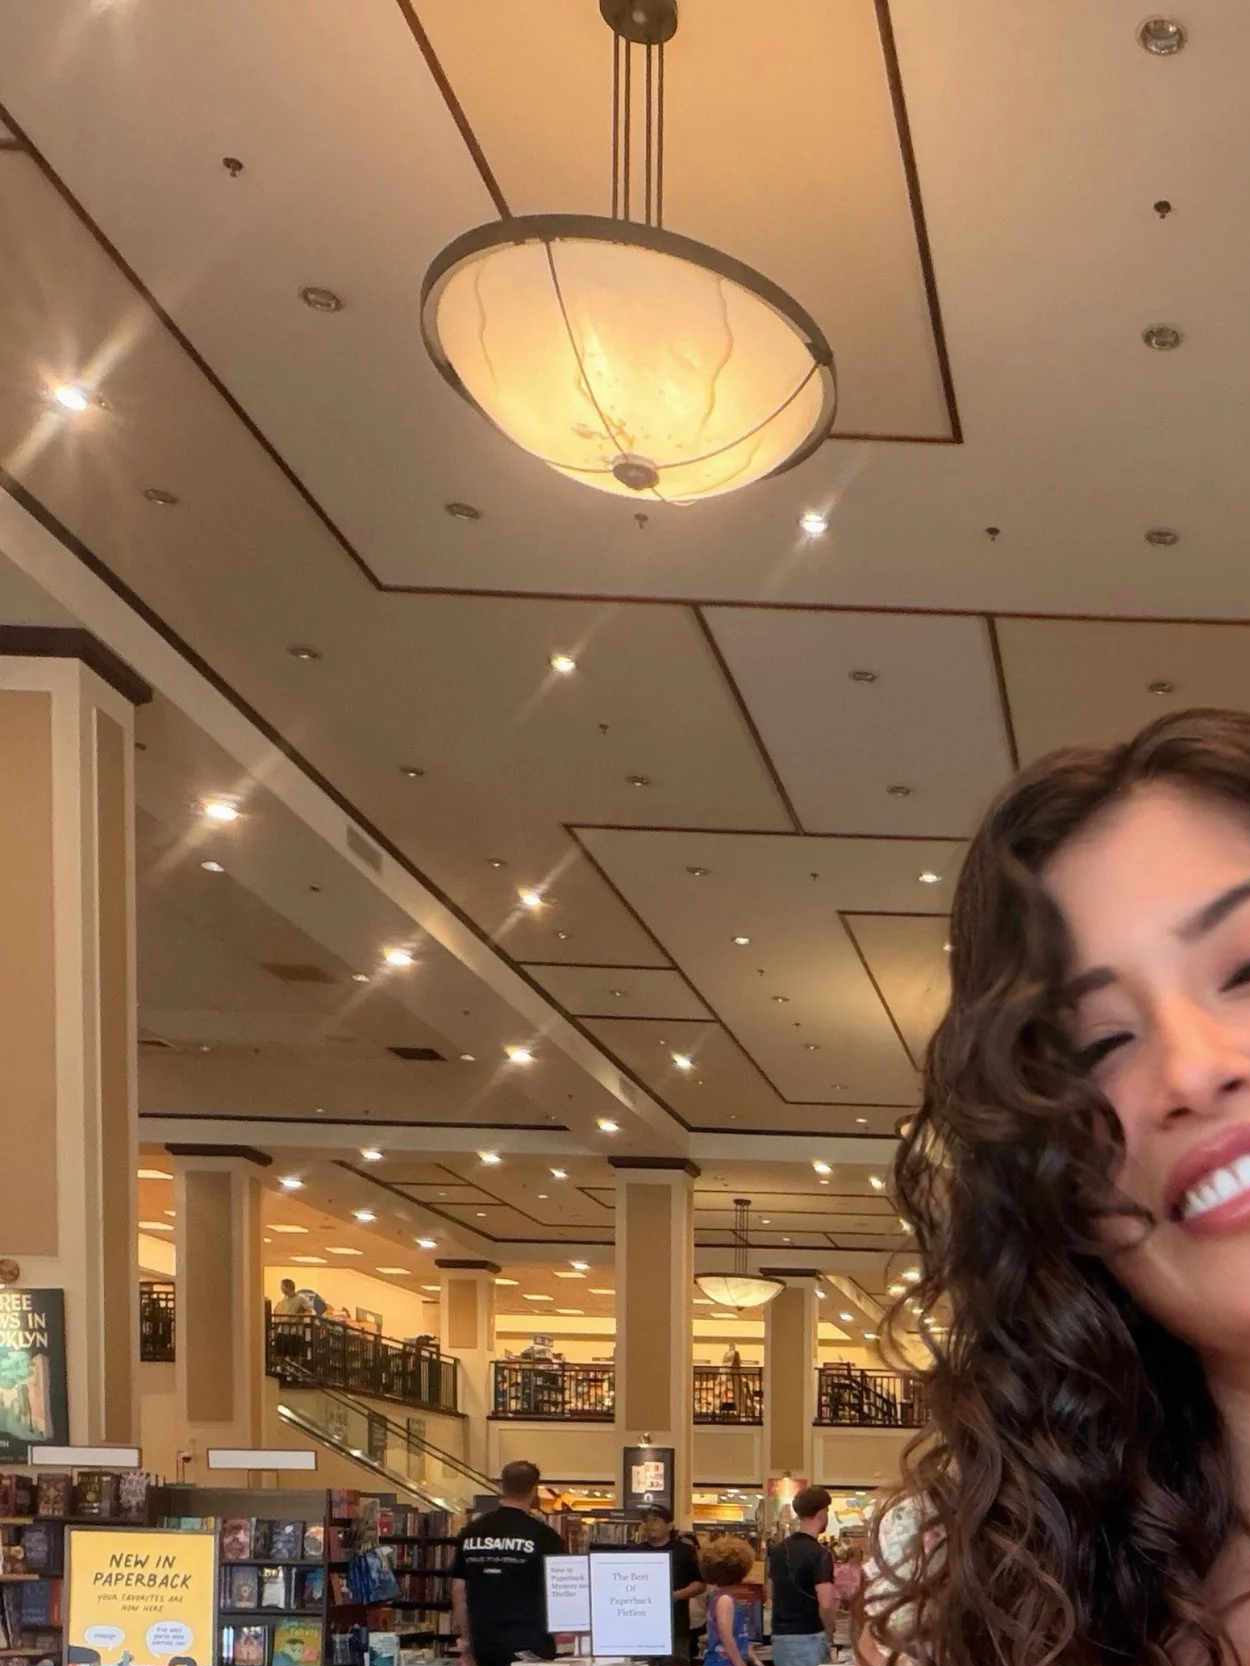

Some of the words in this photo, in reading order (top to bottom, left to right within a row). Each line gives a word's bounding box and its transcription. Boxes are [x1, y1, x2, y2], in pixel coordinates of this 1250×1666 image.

[0, 1293, 32, 1311] REE
[28, 1312, 46, 1329] IN
[463, 1537, 535, 1553] ALLSAINTS
[109, 1552, 149, 1569] NEW
[155, 1555, 176, 1569] IN
[93, 1572, 192, 1589] PAPERBACK
[612, 1573, 628, 1581] The
[631, 1573, 649, 1581] Best
[625, 1584, 637, 1593] Of
[97, 1594, 117, 1602] YOUR
[121, 1594, 164, 1603] FAVORITES
[168, 1595, 183, 1603] ARE
[610, 1596, 653, 1606] Paperback
[617, 1608, 647, 1617] Fiction
